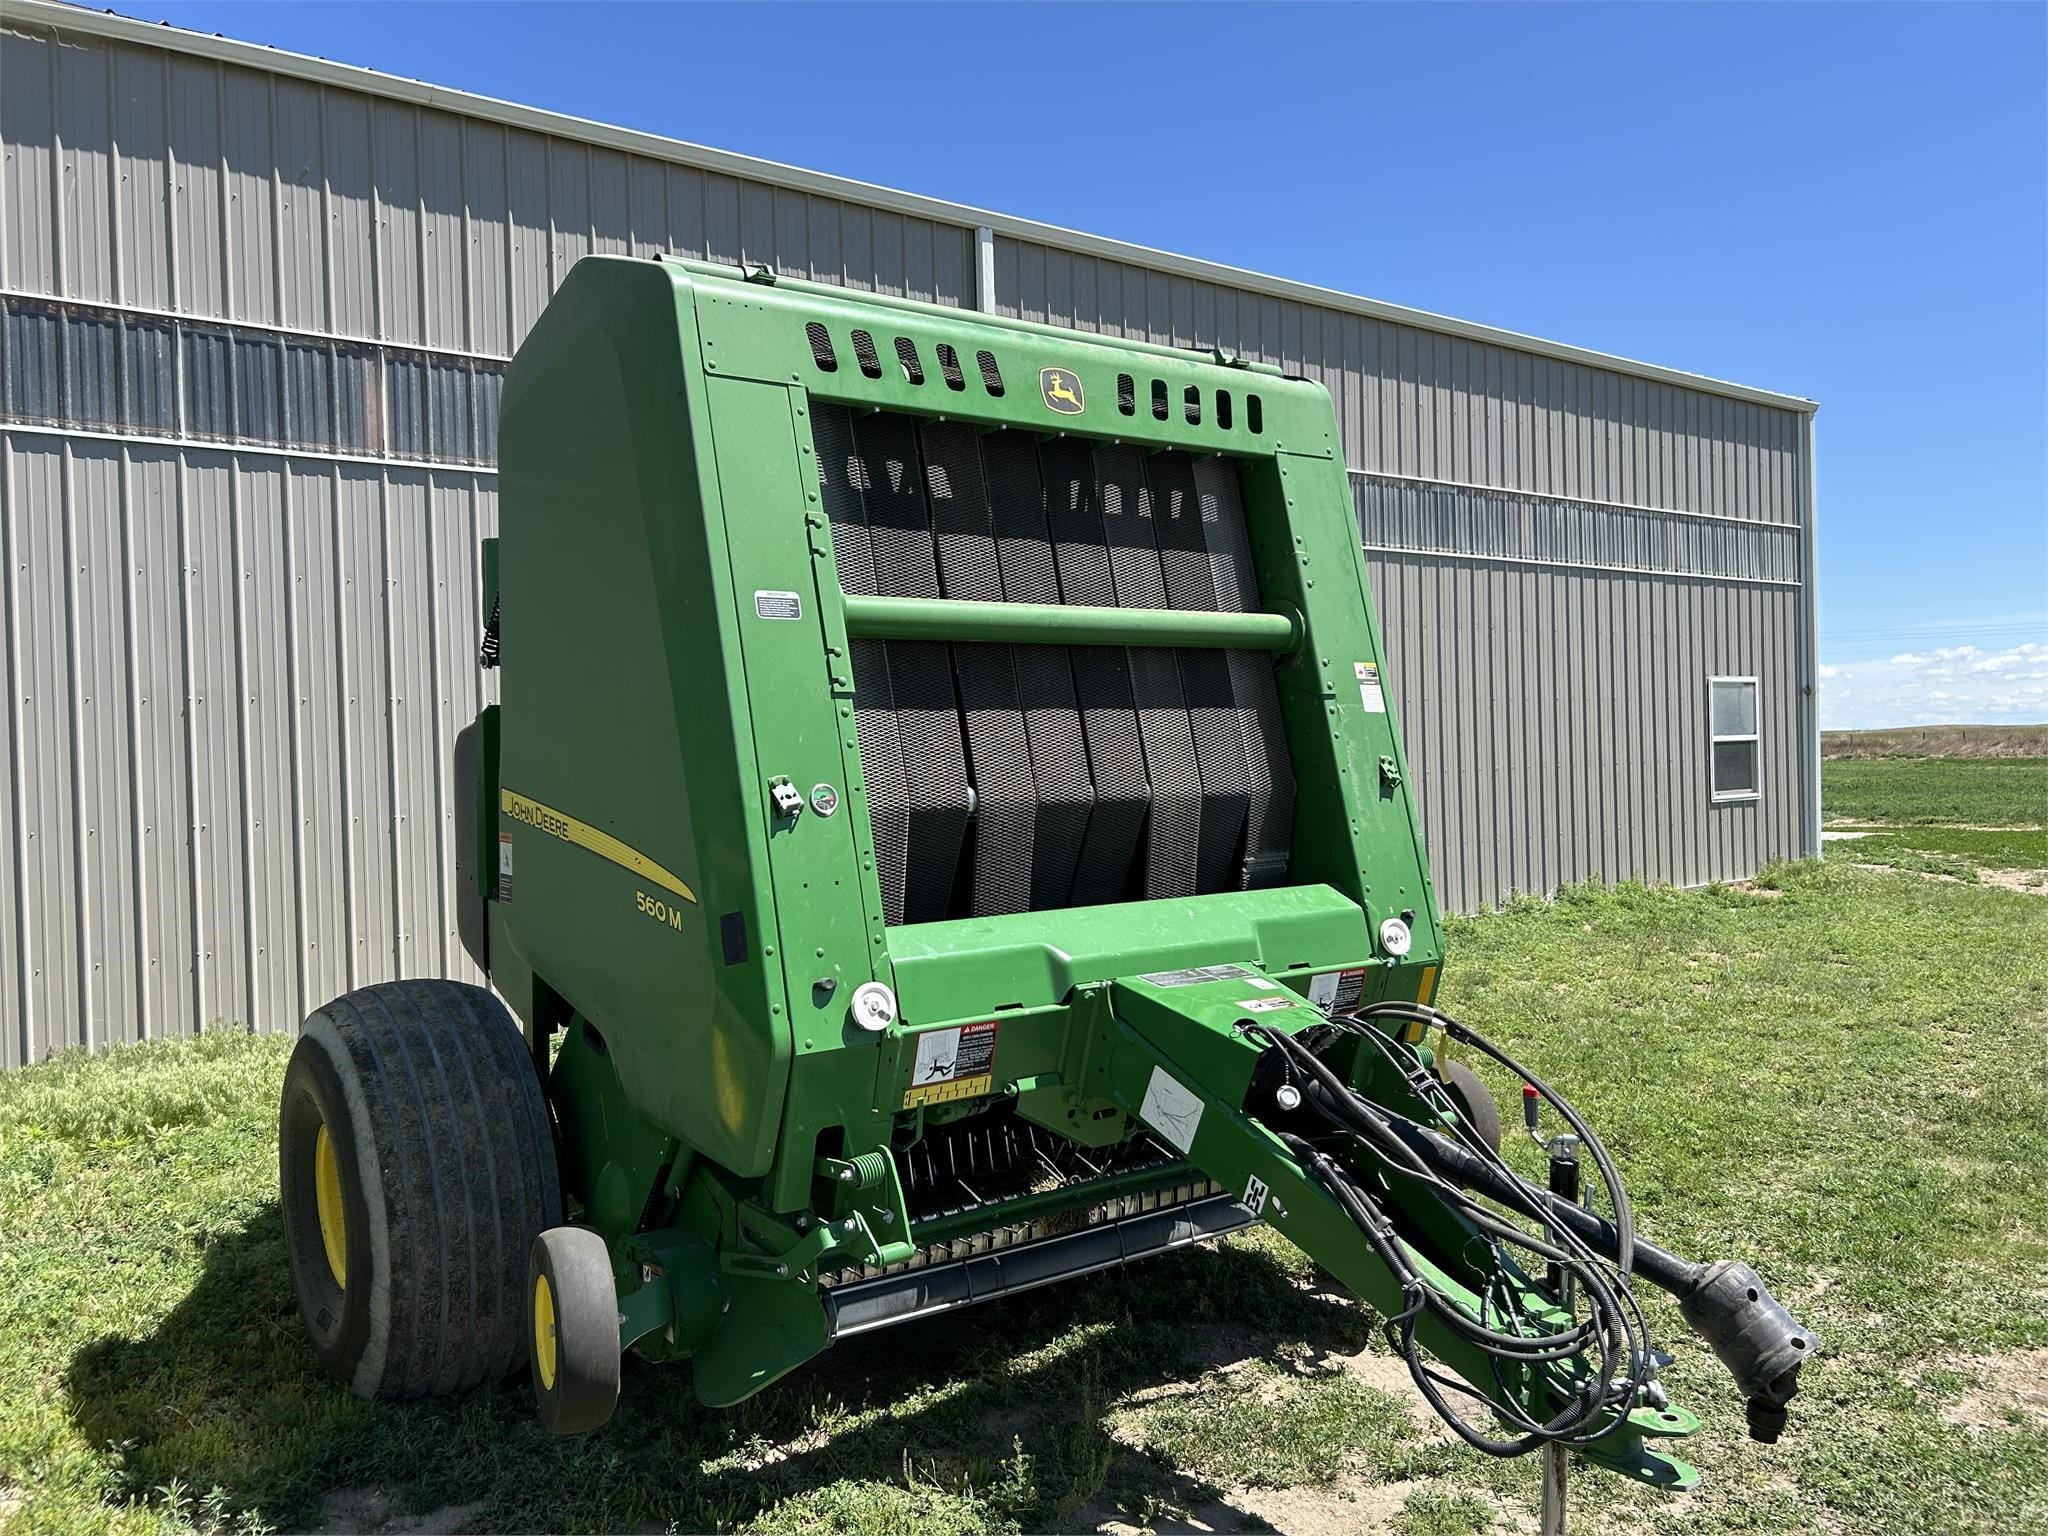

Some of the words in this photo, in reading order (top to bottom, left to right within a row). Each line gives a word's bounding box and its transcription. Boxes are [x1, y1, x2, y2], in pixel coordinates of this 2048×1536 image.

[509, 797, 534, 824] JOHN
[535, 806, 569, 839] DEERE
[636, 890, 666, 922] 560
[668, 905, 682, 931] M
[970, 1023, 995, 1033] DANGER
